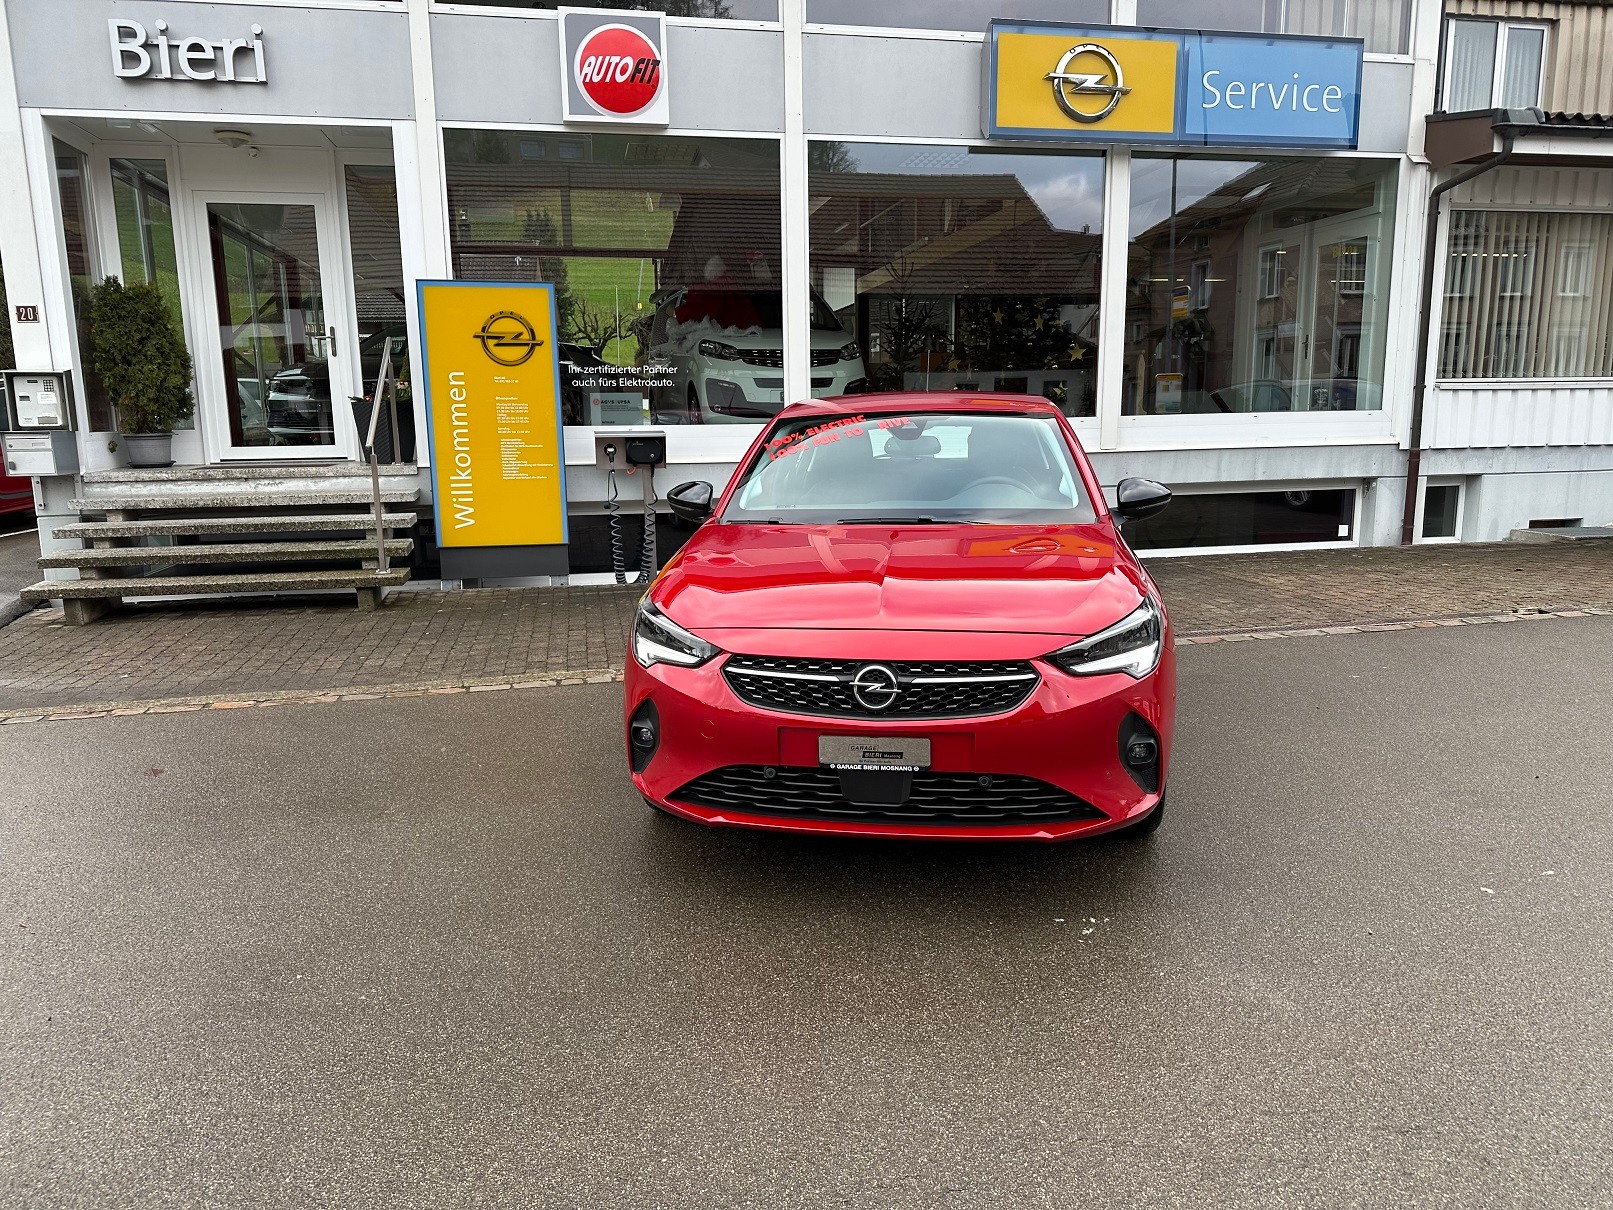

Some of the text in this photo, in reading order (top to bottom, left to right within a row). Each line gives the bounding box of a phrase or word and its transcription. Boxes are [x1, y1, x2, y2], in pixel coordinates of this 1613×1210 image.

[108, 18, 267, 83] Bieri
[1201, 70, 1342, 113] Service
[20, 307, 34, 321] 20
[568, 365, 678, 374] Ihr zertifizierter Partner
[571, 377, 675, 387] auch fürs Elektroauto.
[449, 371, 476, 529] Willkommen
[764, 415, 866, 451] 100% ELECTRIC
[768, 442, 809, 460] 100%
[812, 432, 841, 447] FUN
[844, 427, 864, 438] TO
